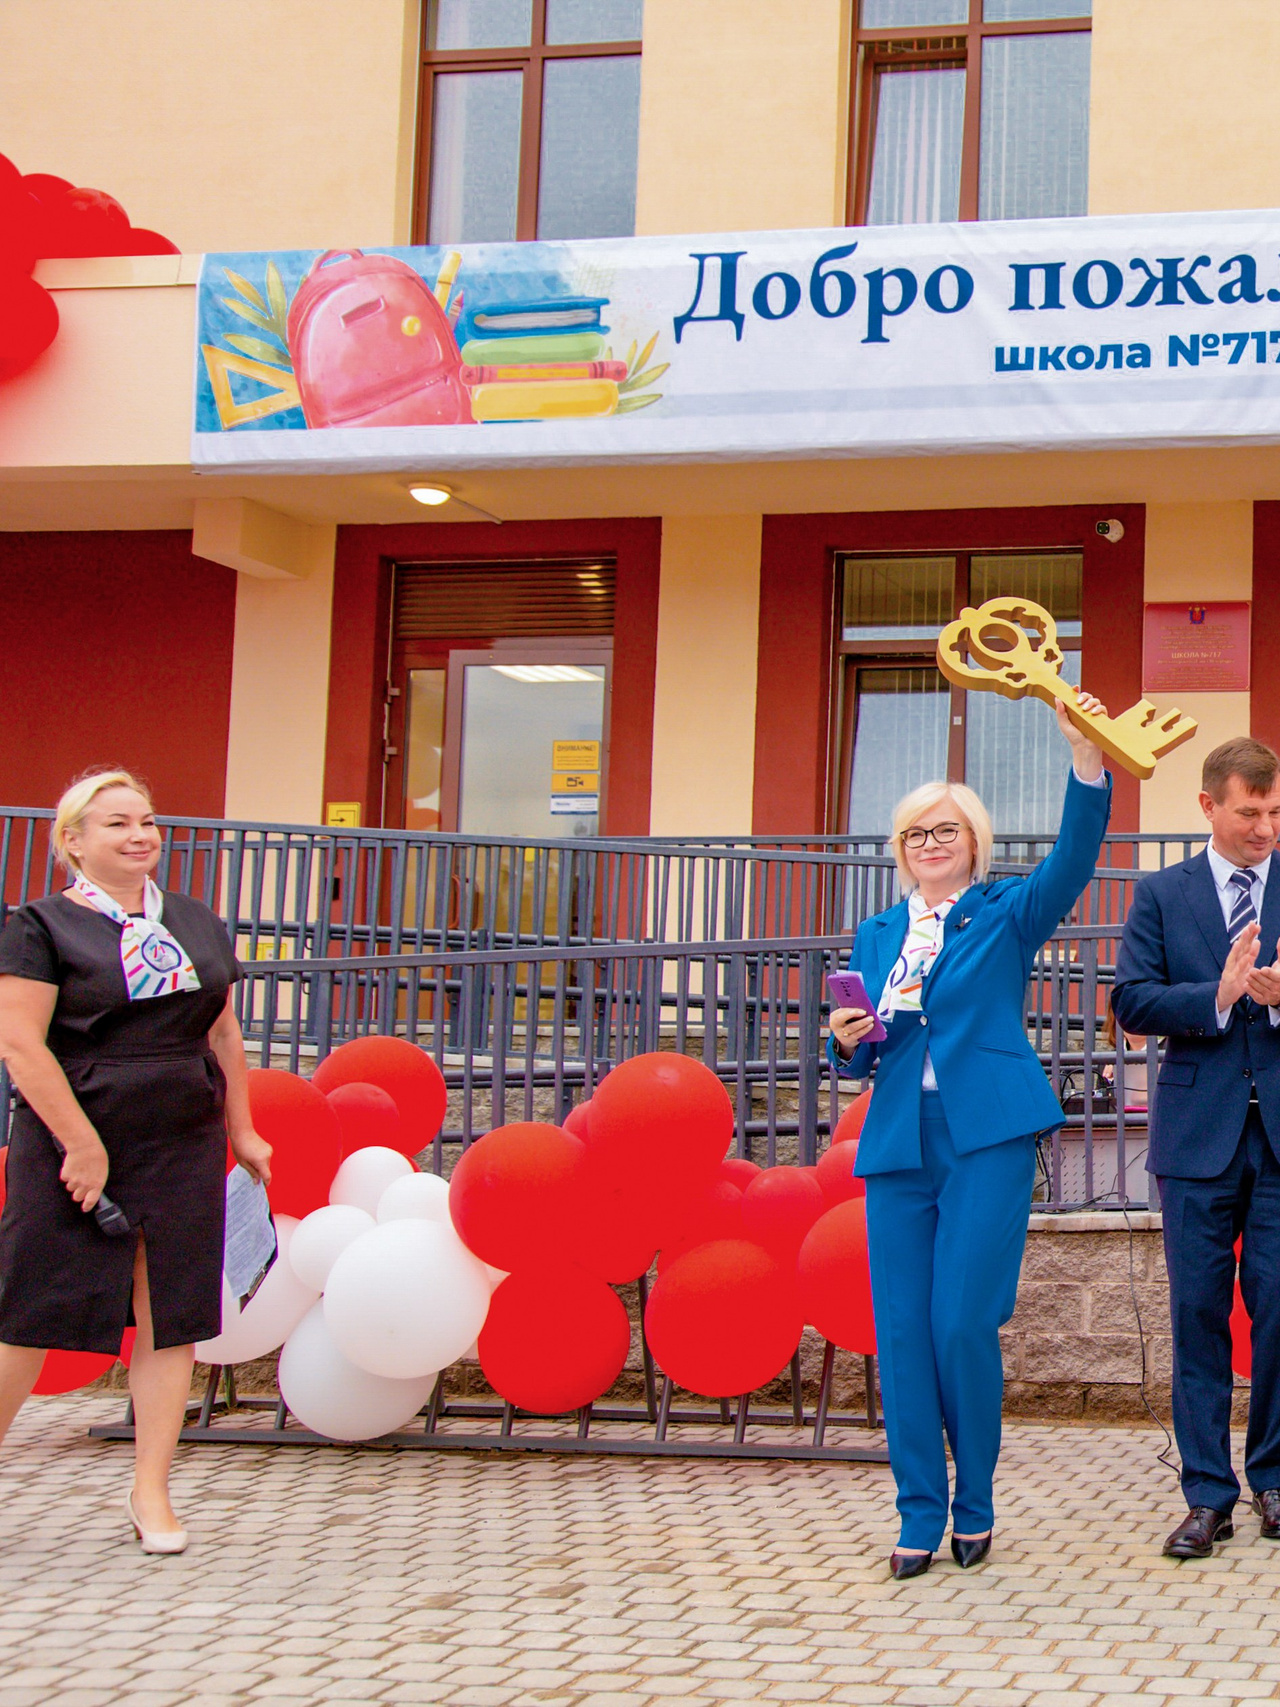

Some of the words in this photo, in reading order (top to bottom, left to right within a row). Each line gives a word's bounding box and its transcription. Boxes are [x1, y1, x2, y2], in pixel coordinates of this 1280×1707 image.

[672, 241, 975, 344] Добро
[994, 342, 1152, 373] школа
[1171, 651, 1200, 659] ШКОЛА
